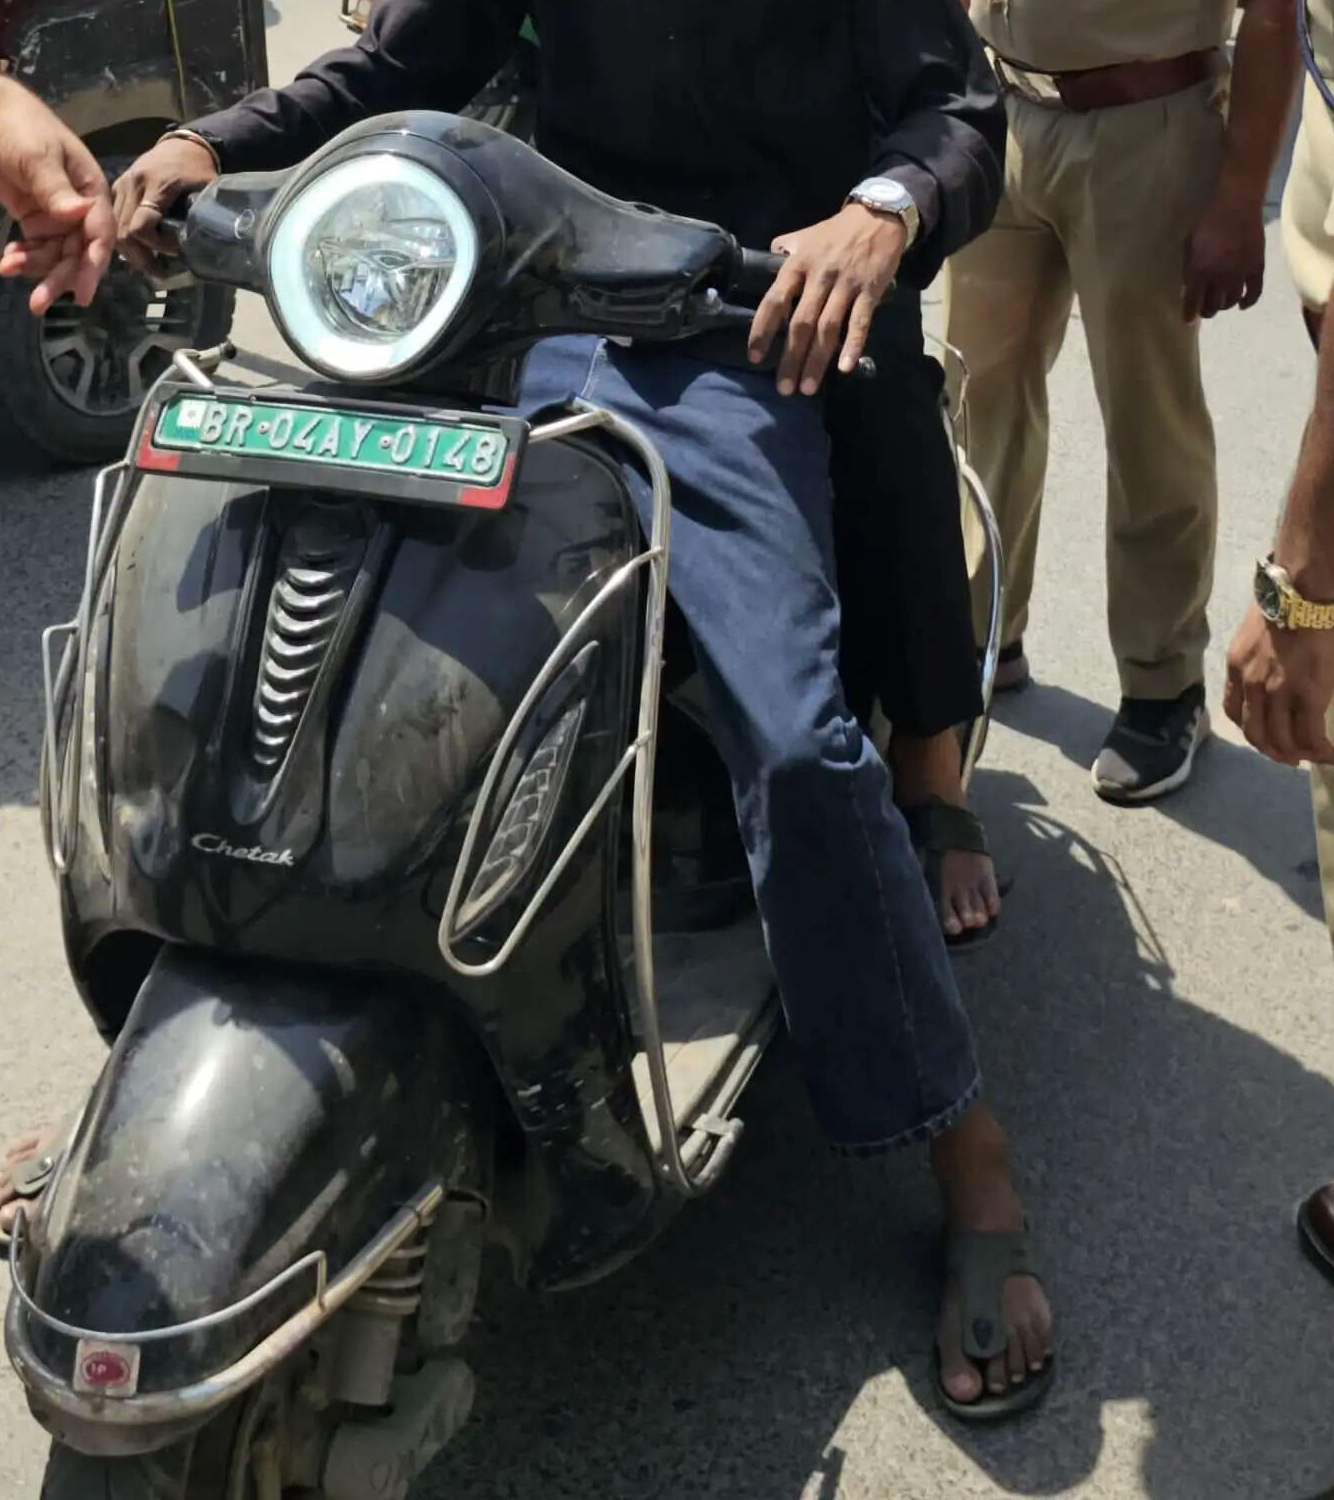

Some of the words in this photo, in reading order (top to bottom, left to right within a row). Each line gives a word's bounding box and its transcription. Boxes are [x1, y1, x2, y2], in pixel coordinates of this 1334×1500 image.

[199, 404, 253, 448] BR
[269, 411, 375, 460] 04AY
[389, 422, 498, 475] 0148
[191, 833, 295, 866] Chetak
